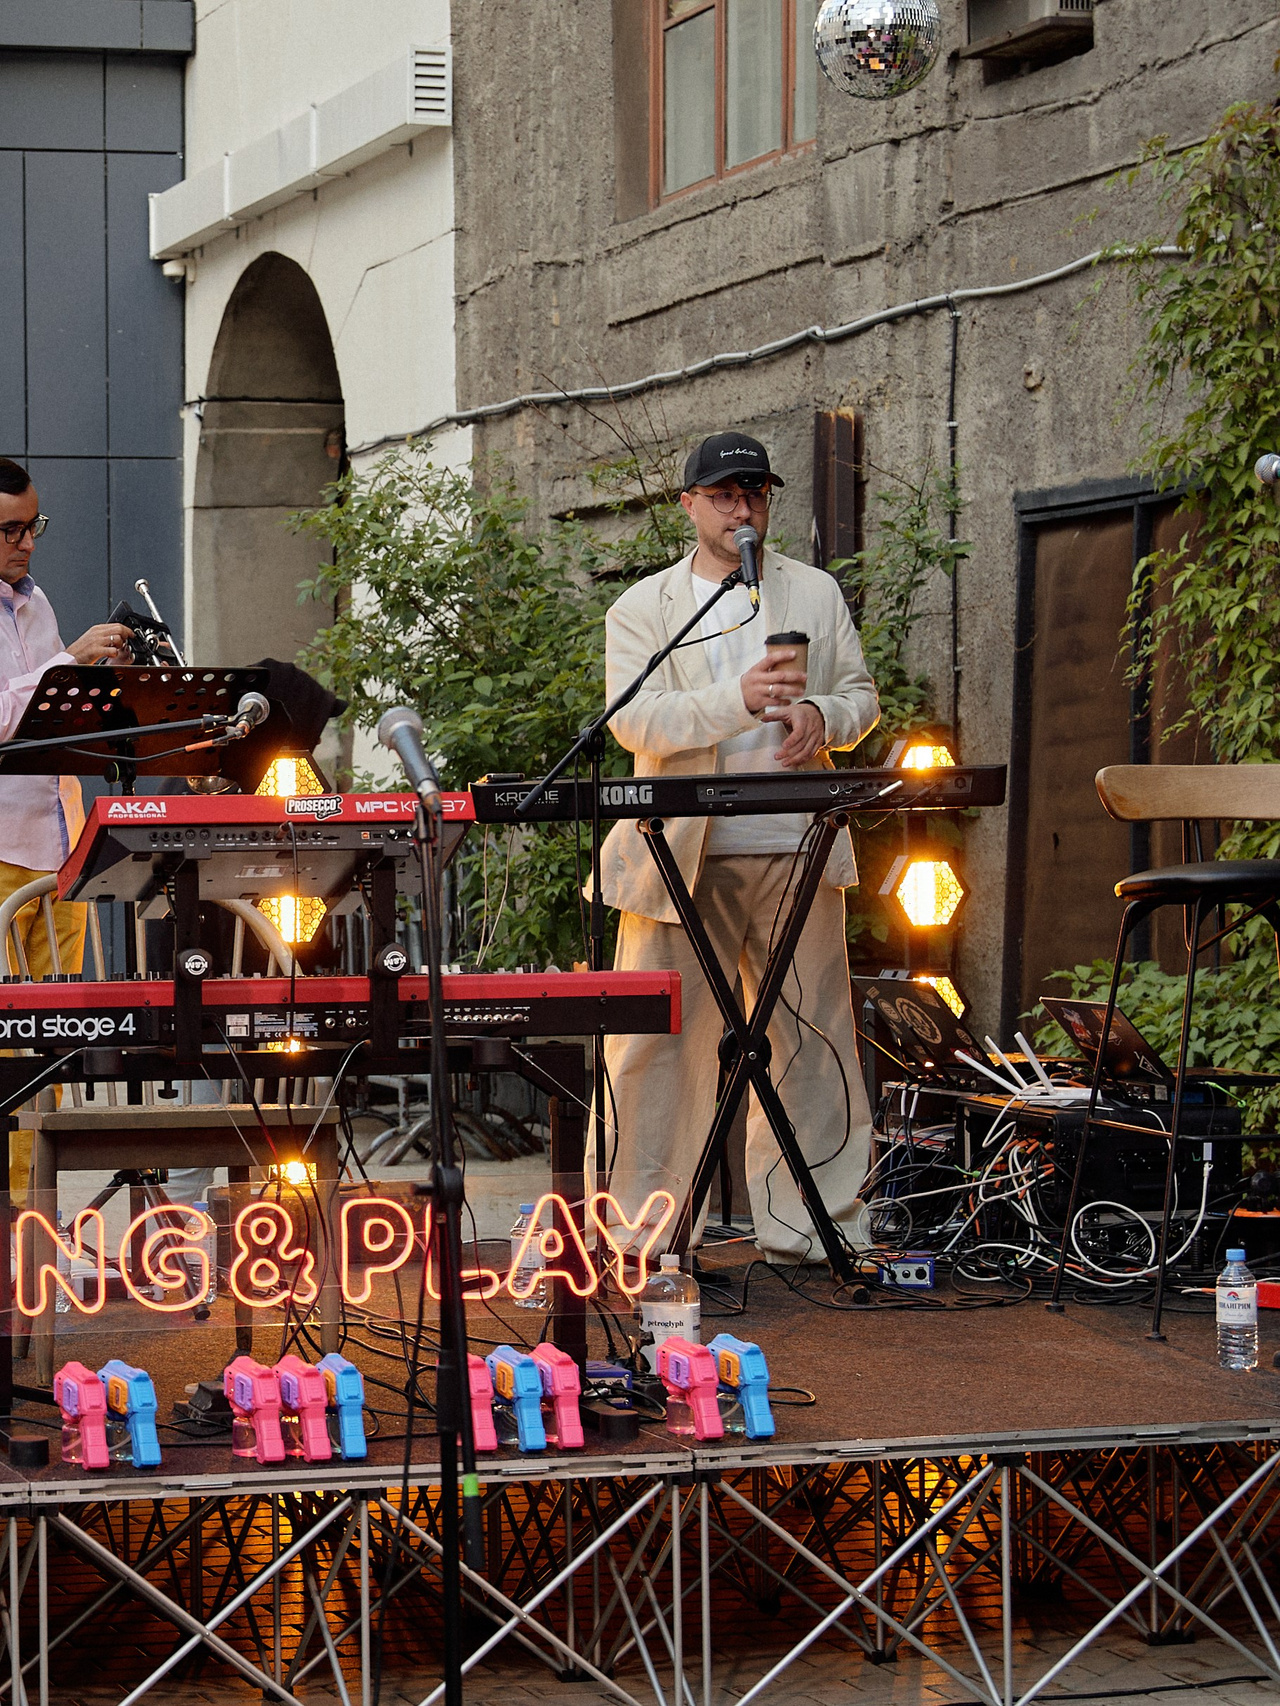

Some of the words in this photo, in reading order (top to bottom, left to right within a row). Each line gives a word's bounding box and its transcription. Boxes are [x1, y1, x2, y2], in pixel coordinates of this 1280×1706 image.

[495, 790, 559, 802] KROE
[599, 785, 653, 805] KORG
[108, 801, 167, 814] AKAI
[288, 799, 337, 813] PROSECCO
[355, 801, 399, 813] MPC
[42, 1014, 116, 1041] stage
[118, 1013, 136, 1036] 4
[647, 1320, 684, 1329] petroglyph
